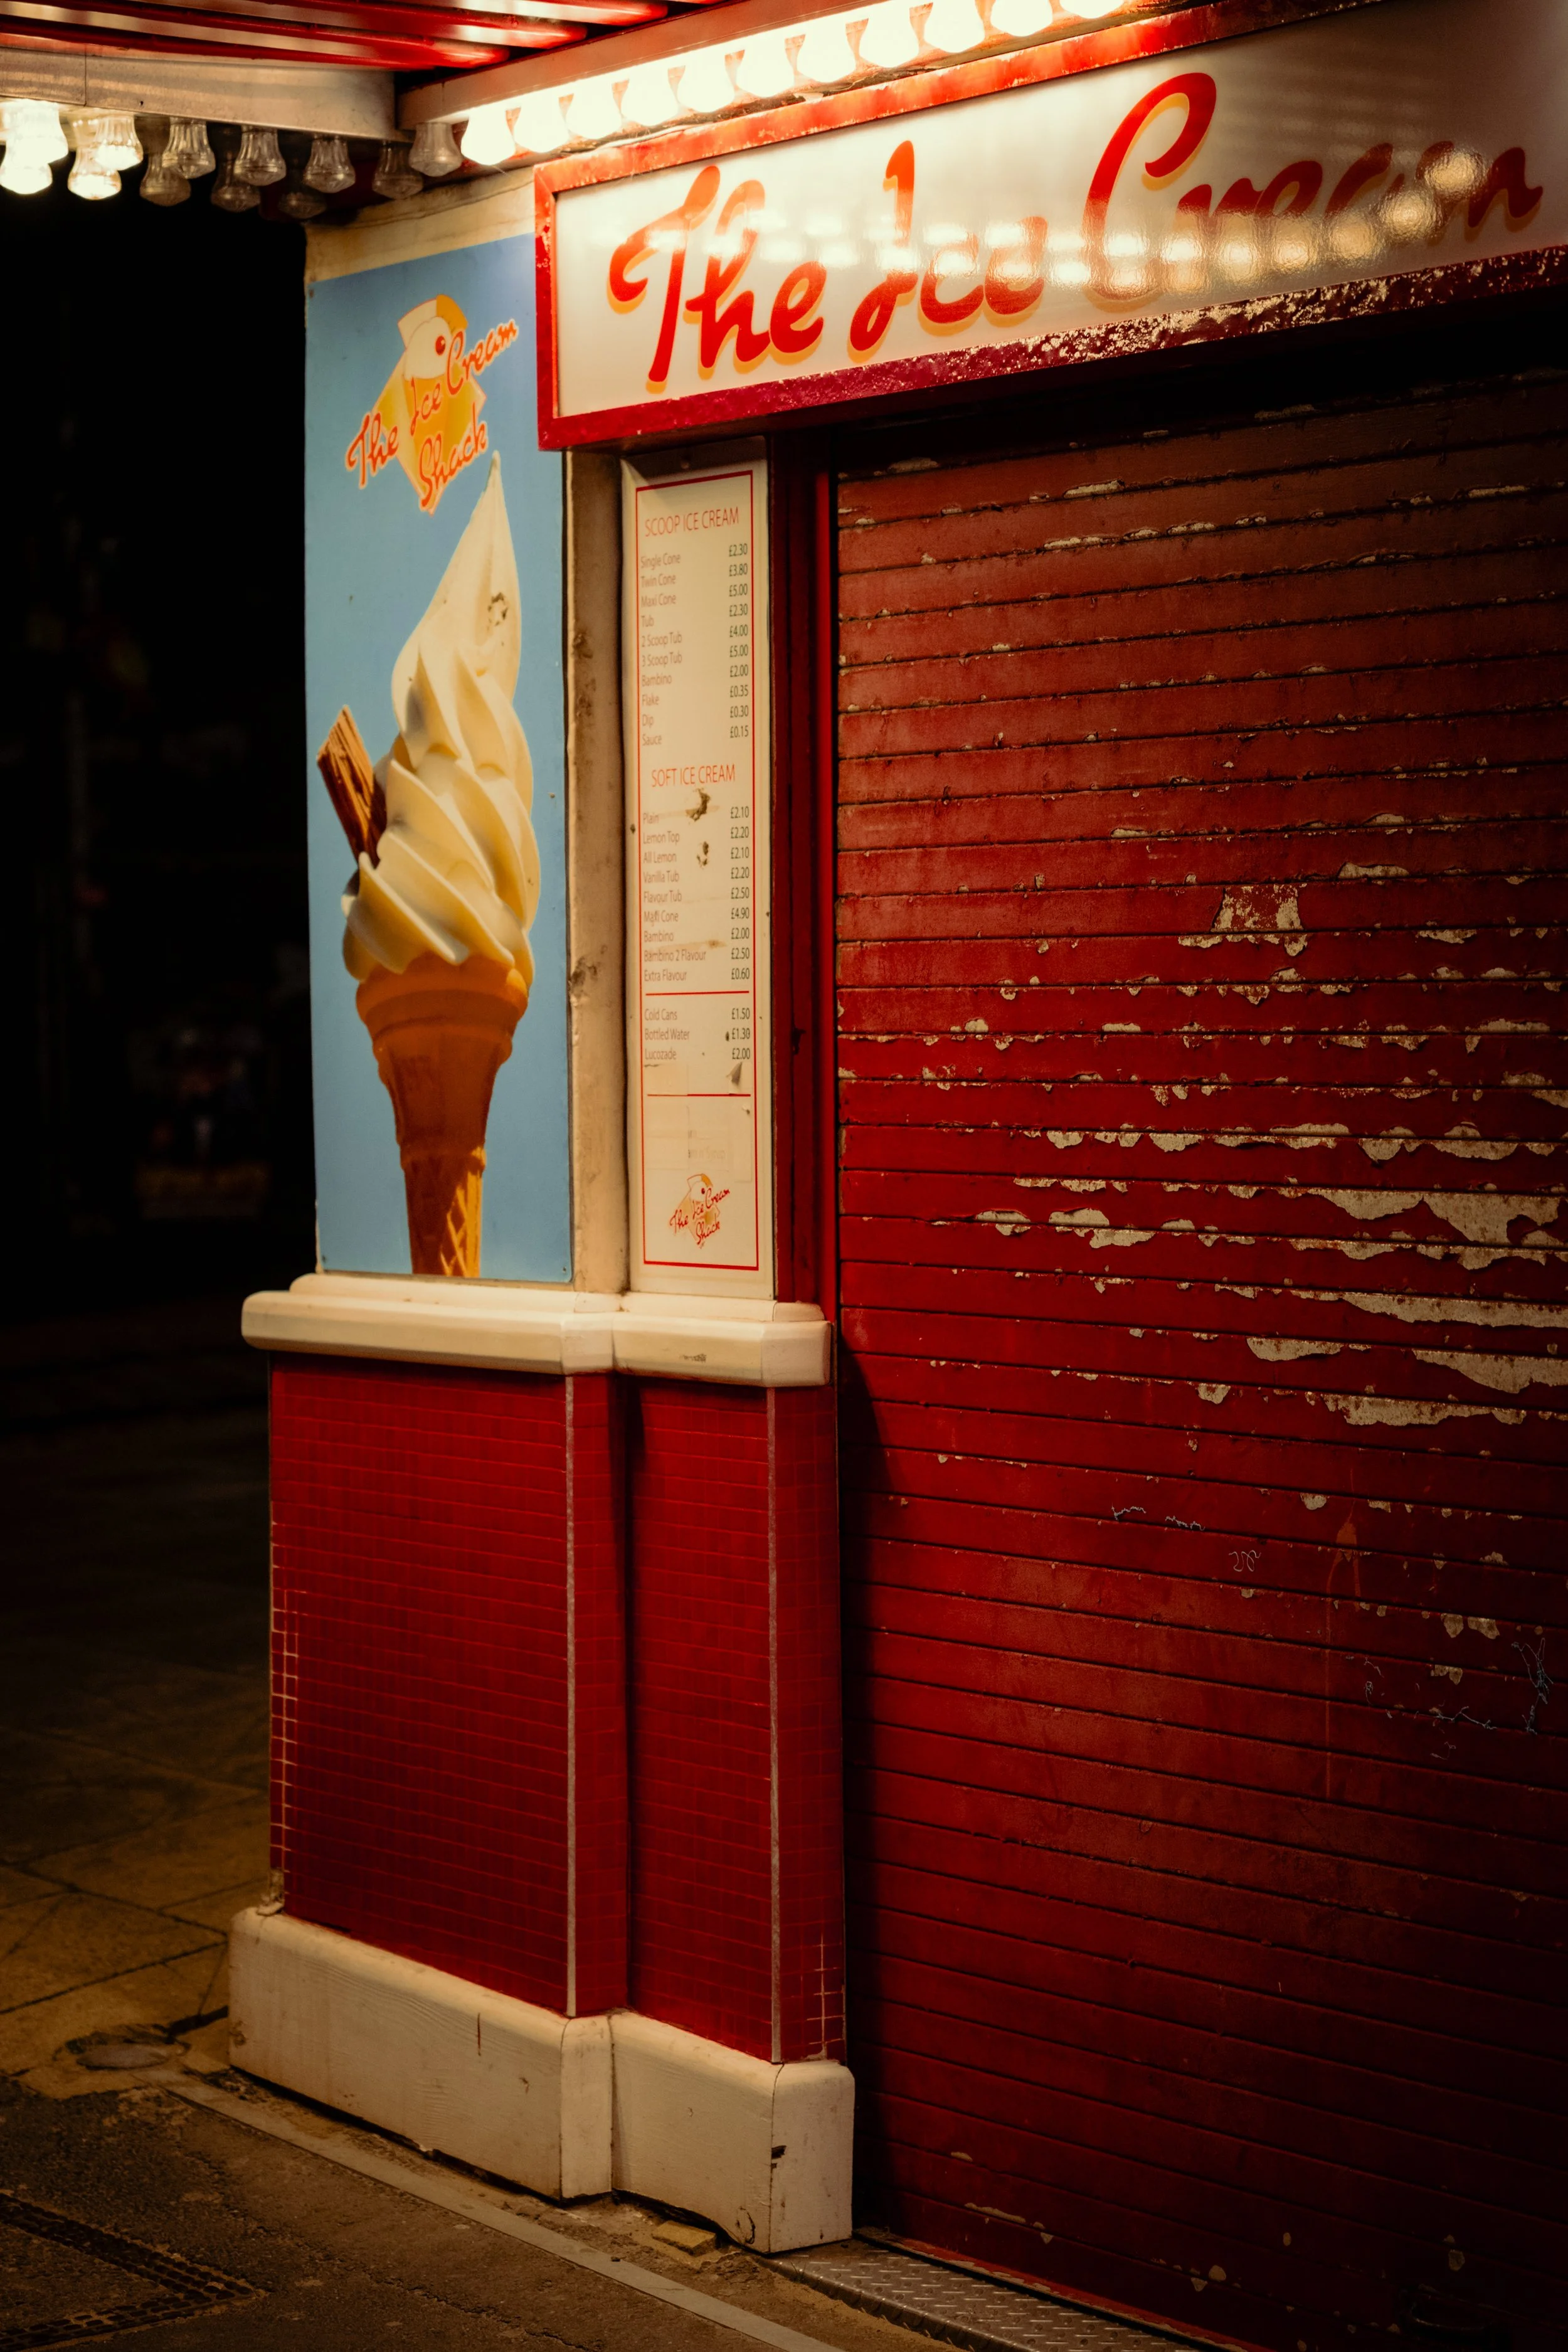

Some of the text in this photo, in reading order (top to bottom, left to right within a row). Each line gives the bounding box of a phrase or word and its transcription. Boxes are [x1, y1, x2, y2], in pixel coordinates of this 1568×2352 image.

[607, 72, 1543, 392] The Ice Cream
[346, 319, 518, 489] The Ice Cream
[419, 403, 488, 509] Shack
[645, 507, 739, 537] SCOOP ICE CREAM
[640, 543, 748, 570] Single Cone £2.30
[641, 563, 748, 588] Twin Cone £3.80
[641, 583, 748, 608] Maxi Cone £5.00
[641, 603, 748, 627] Tub £2.30
[642, 624, 748, 647] 2 Scoop Tub £4.00
[642, 645, 748, 667] 3 Scoop Tub £5.00
[642, 664, 748, 687] Bambino £2.00
[642, 684, 748, 706] Flake £0.35
[642, 705, 749, 728] Dip £0.30
[642, 725, 749, 746] Sauce £0.15
[652, 764, 735, 787] SOFT ICE CREAM
[643, 807, 750, 824] Plain £2.10
[643, 827, 750, 844] Lemon Top £2.20
[644, 847, 750, 864] All Lemon £2.10
[644, 867, 750, 883] Vanilla Tub £2.20
[644, 887, 750, 903] Flavour Tub £2.50
[661, 910, 679, 922] Cone
[731, 908, 750, 919] £4.90
[644, 928, 750, 941] Bambino £2.00
[644, 948, 750, 962] Bambino 2 Flavour £2.50
[644, 968, 750, 982] Extra Flavour £0.60
[644, 1007, 750, 1020] Cold Cans £1.50
[645, 1028, 750, 1041] Bottled Water £1.30
[645, 1047, 750, 1060] Lucozade £2.00
[669, 1187, 730, 1236] The Ice Cream
[696, 1213, 720, 1245] Shack
